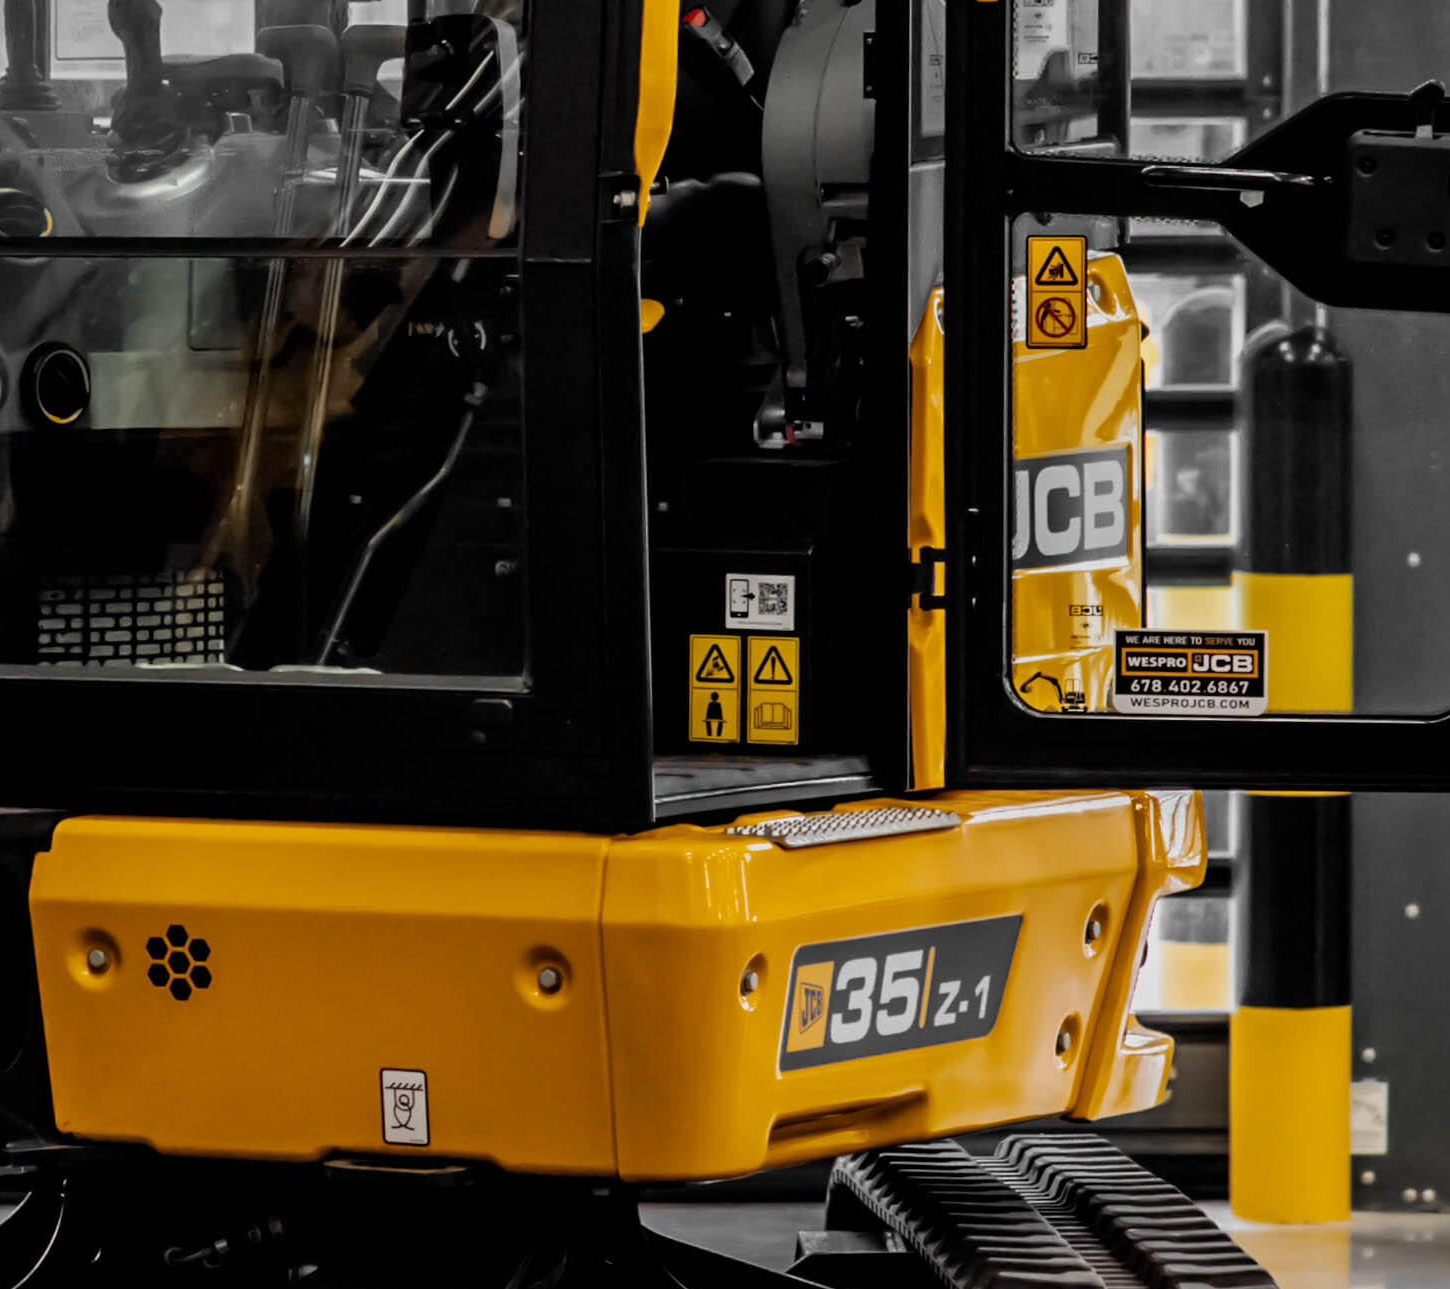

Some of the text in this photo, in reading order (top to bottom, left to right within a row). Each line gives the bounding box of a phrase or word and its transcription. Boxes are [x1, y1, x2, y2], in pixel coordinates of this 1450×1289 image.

[1012, 460, 1125, 561] JCB
[1126, 635, 1255, 646] WE ARE HERE TO SERVE YOU
[1127, 654, 1253, 672] WESPRO JCB
[1130, 679, 1249, 694] 678.402.6867
[1130, 698, 1250, 709] WESPROJCB.COM
[830, 949, 924, 1044] 35
[800, 983, 824, 1030] JCB
